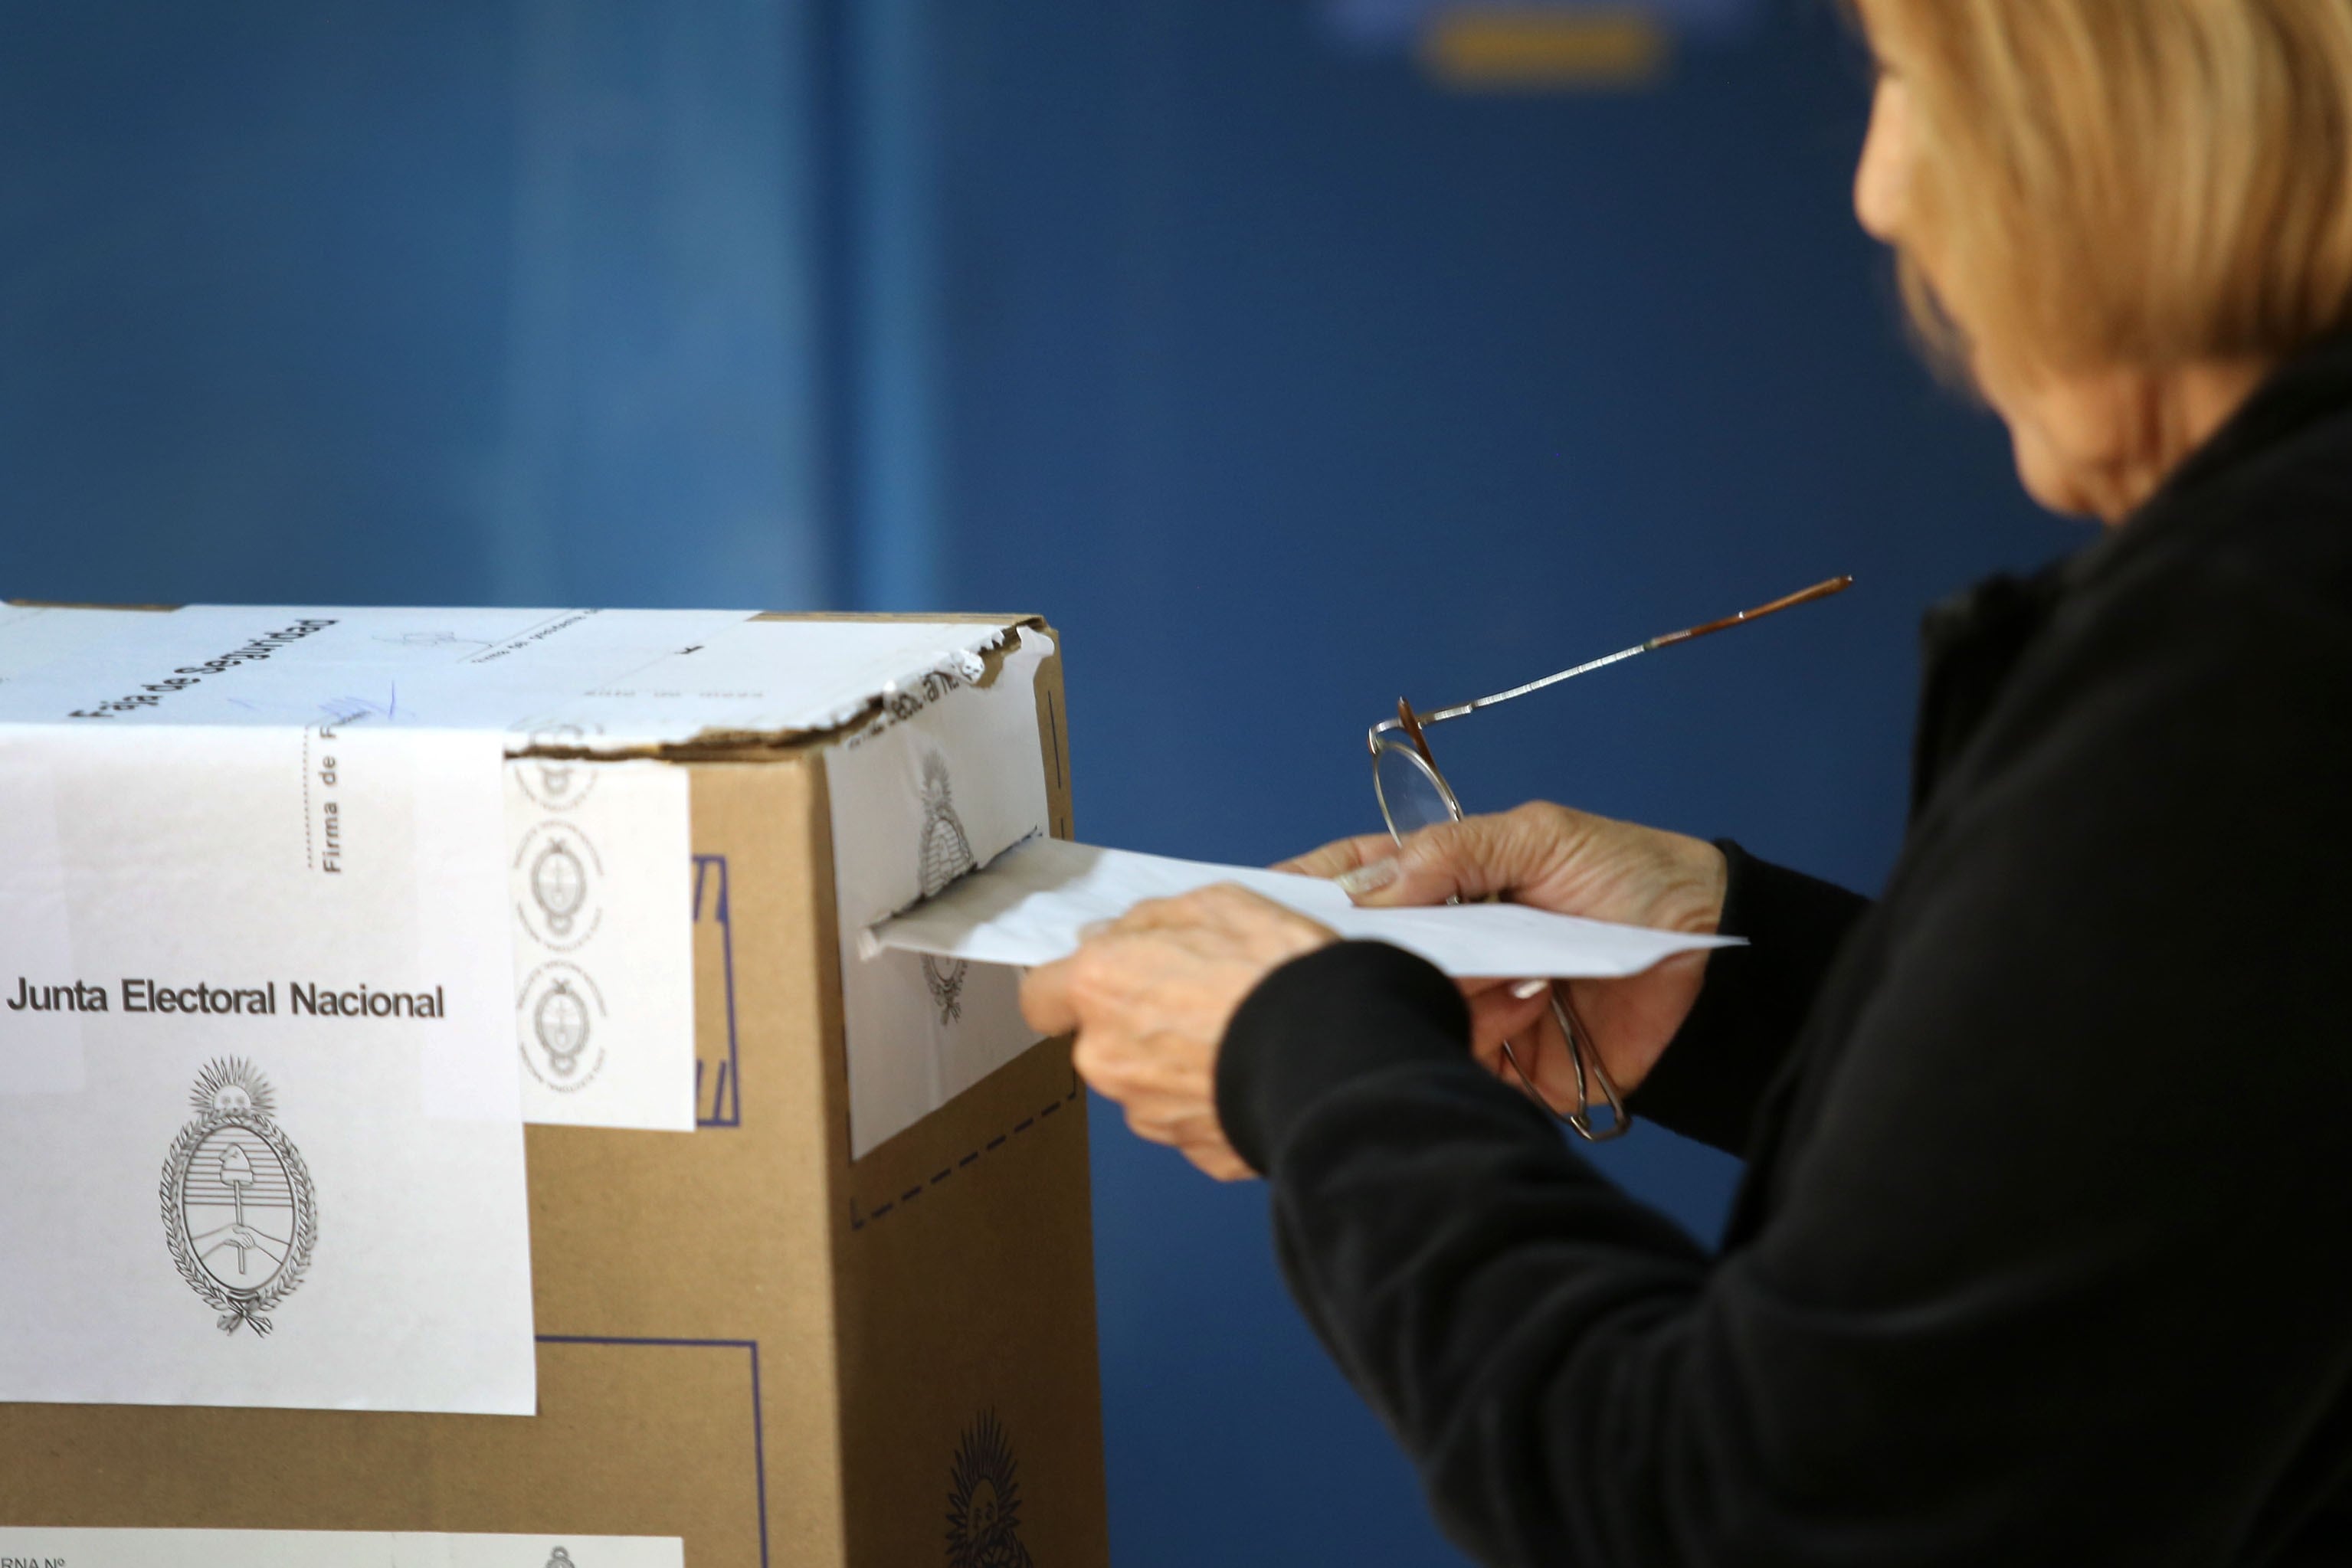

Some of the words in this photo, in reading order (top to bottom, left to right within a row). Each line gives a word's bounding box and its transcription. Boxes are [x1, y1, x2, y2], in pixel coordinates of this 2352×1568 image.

[68, 695, 162, 718] Faja
[141, 678, 201, 692] de
[173, 618, 339, 674] Seguridad
[318, 756, 337, 787] de
[322, 801, 342, 875] Firma
[6, 977, 108, 1013] Junta
[121, 979, 275, 1015] Electoral
[290, 982, 444, 1019] Nacional
